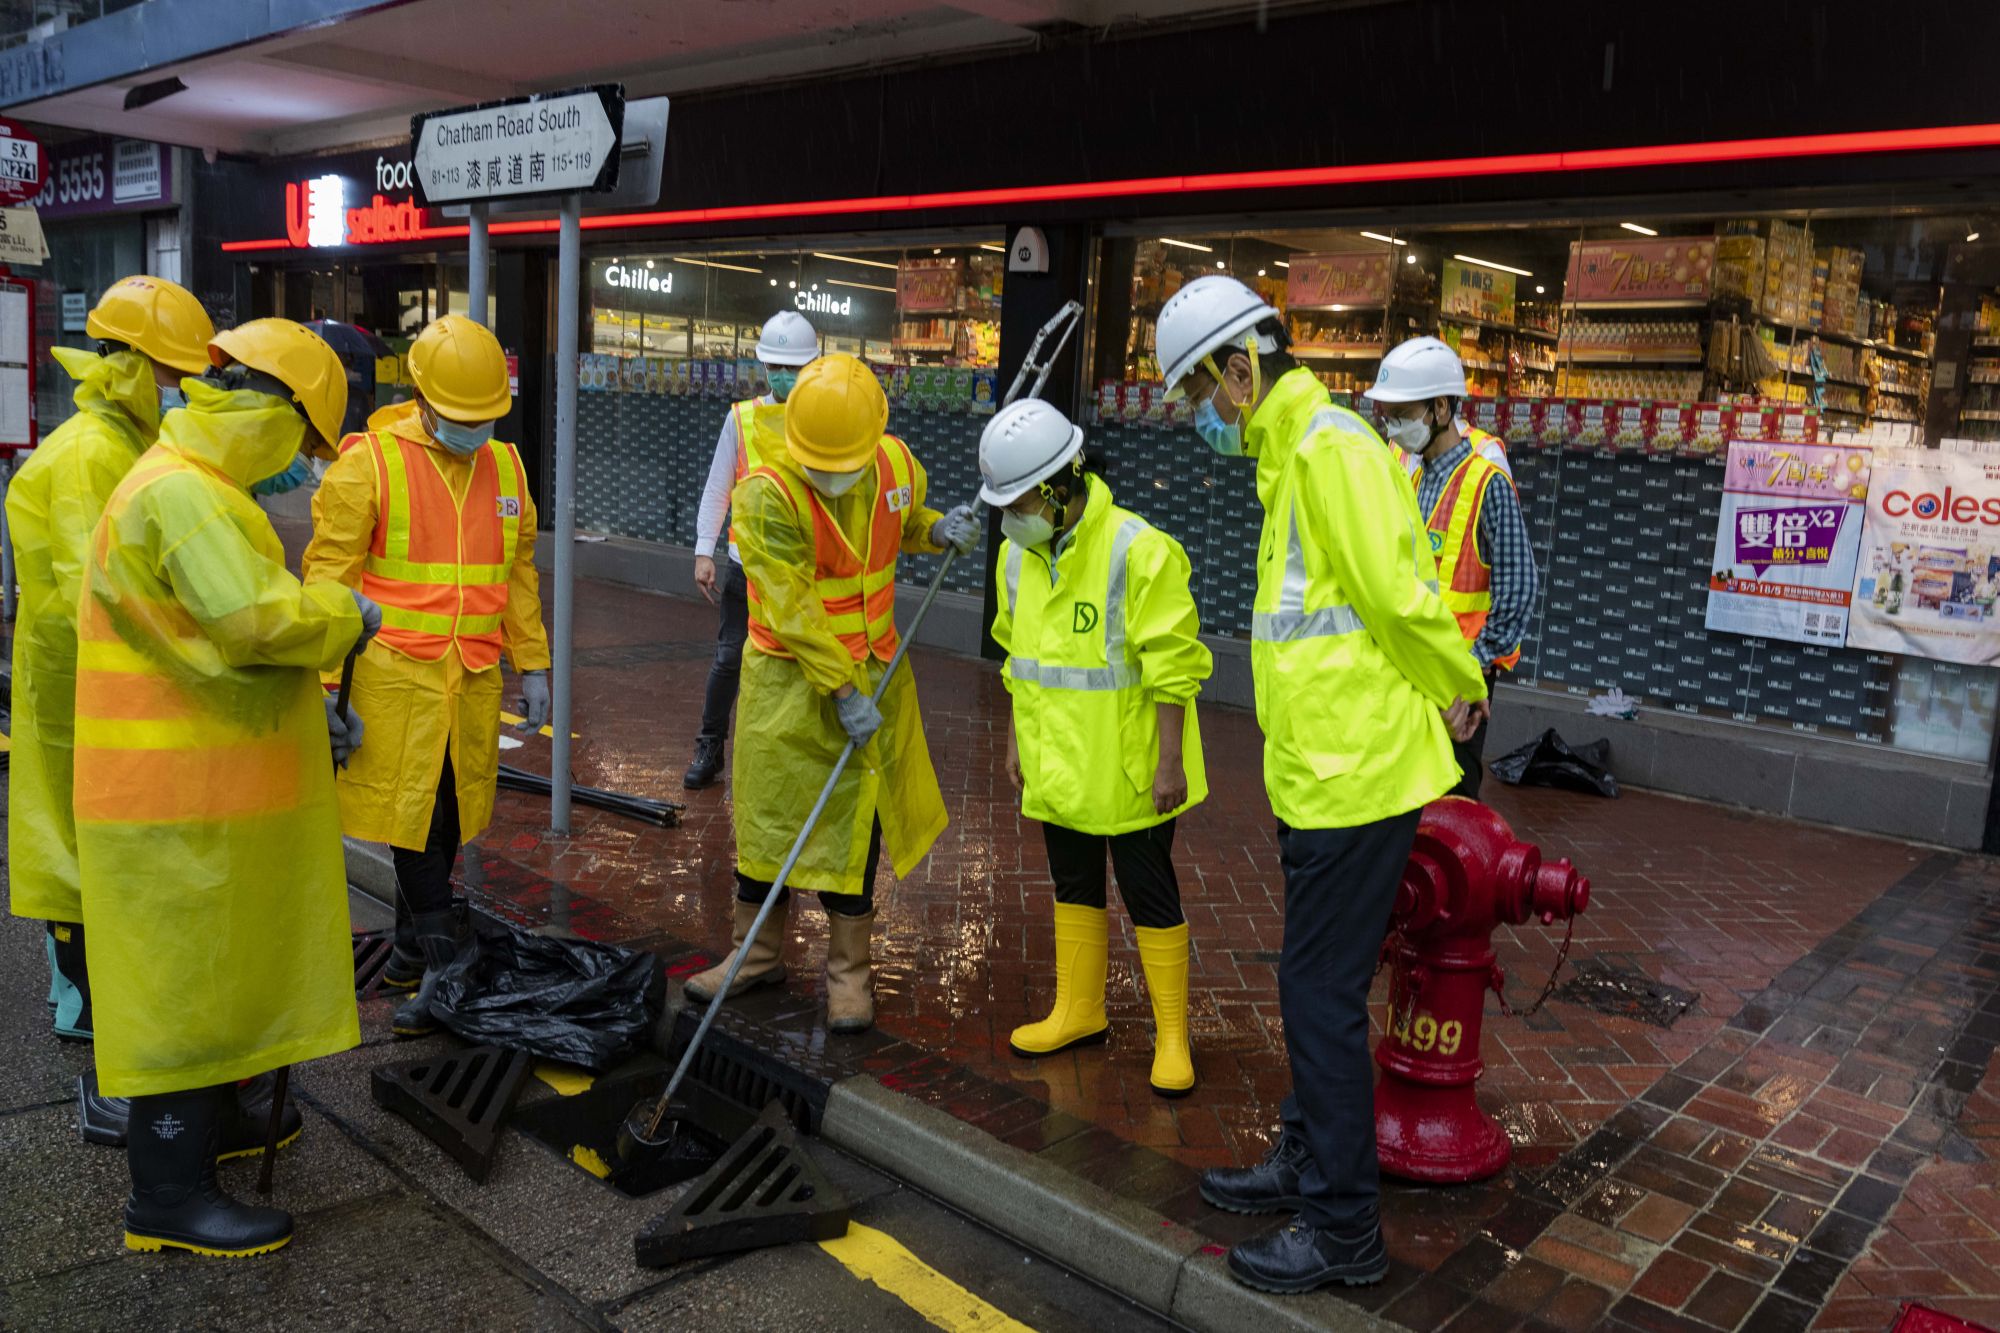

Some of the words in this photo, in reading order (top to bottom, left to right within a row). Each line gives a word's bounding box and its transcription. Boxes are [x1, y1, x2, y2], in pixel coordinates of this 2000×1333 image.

[437, 123, 493, 147] Chatham
[497, 112, 534, 138] Road
[539, 104, 581, 132] South
[11, 142, 28, 159] 5X
[2, 160, 34, 181] N271
[59, 153, 105, 204] 5555
[466, 151, 546, 190] 漆咸道南
[605, 265, 673, 294] Chilled
[795, 290, 851, 316] Chilled
[1808, 509, 1836, 529] X2
[1882, 485, 2000, 526] coles
[1738, 512, 1808, 549] 雙倍
